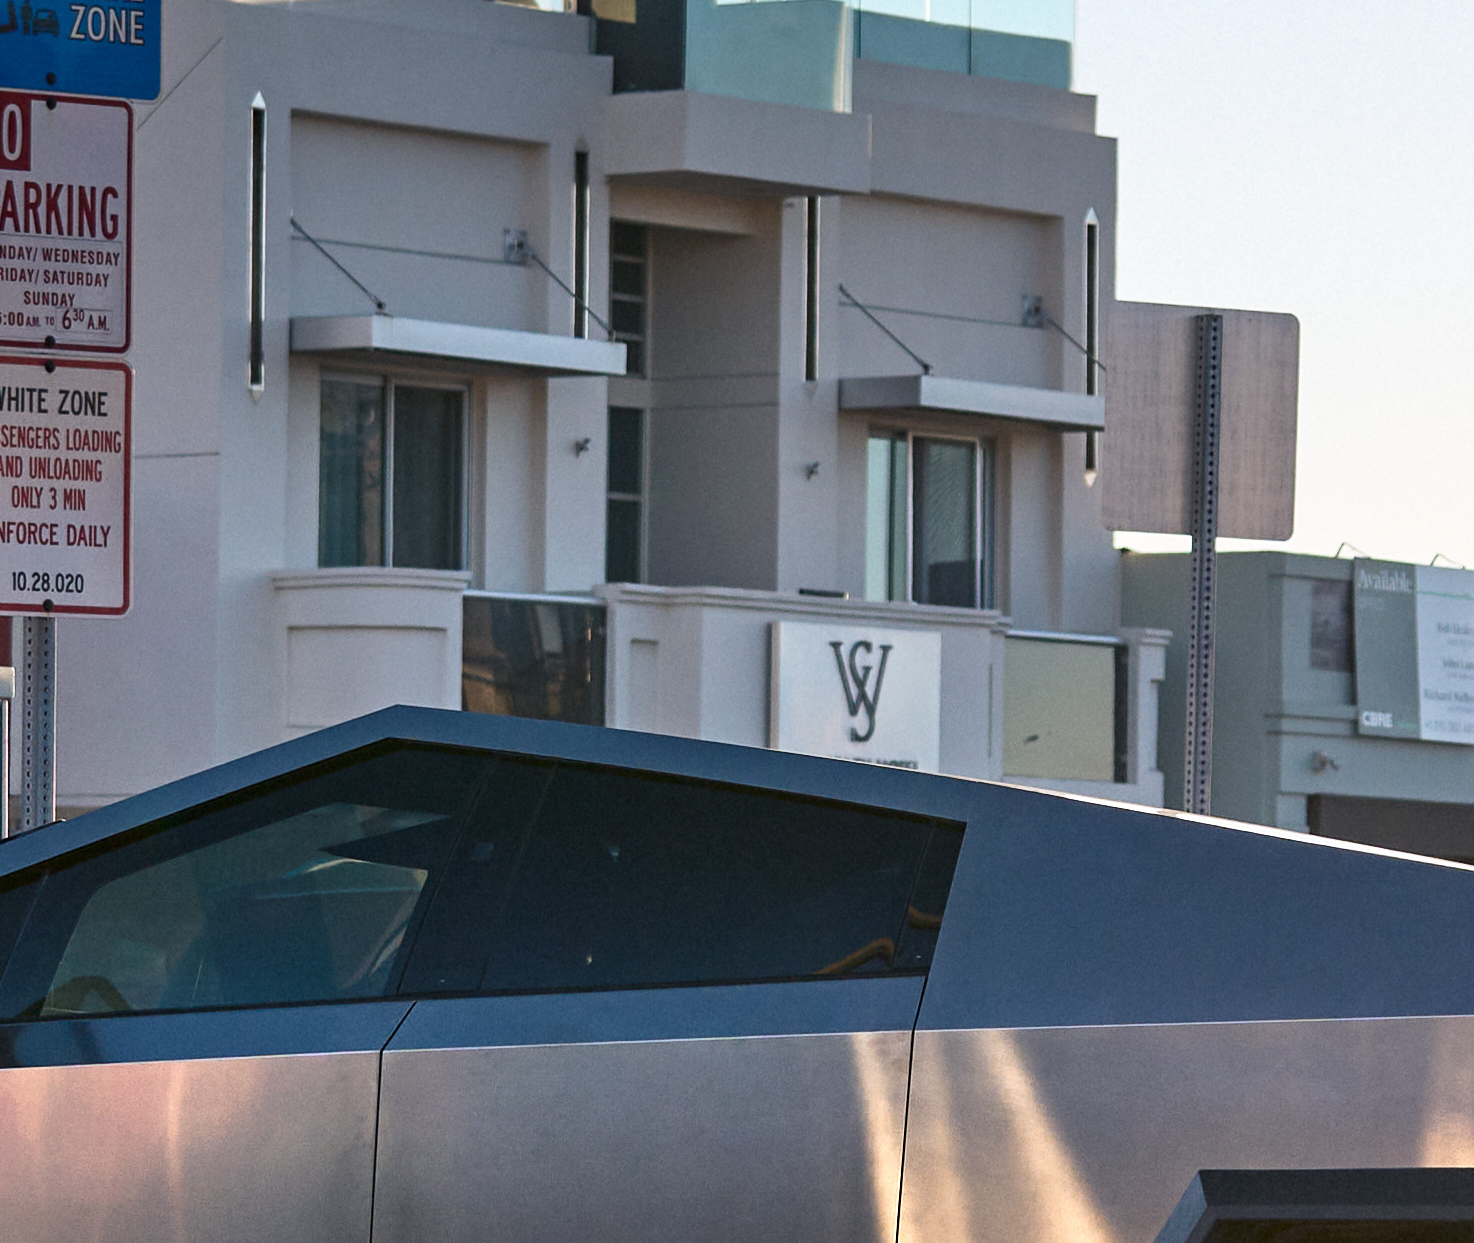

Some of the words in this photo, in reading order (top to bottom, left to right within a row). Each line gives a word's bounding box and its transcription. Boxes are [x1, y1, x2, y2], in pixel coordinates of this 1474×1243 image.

[69, 5, 144, 45] ZONE
[42, 247, 120, 267] WEDNESDAY
[43, 269, 109, 288] SATURDAY
[23, 291, 76, 307] SUNDAY
[45, 316, 54, 326] TO
[58, 389, 108, 417] ZONE
[65, 428, 122, 453] LOADING
[29, 457, 102, 482] UNLOADING
[11, 486, 43, 508] ONLY
[49, 487, 57, 510] 3
[63, 488, 86, 511] MIN
[67, 524, 111, 548] DAILY
[12, 571, 84, 594] 10.28.020
[1358, 569, 1414, 593] Available
[1362, 710, 1393, 729] CBRE
